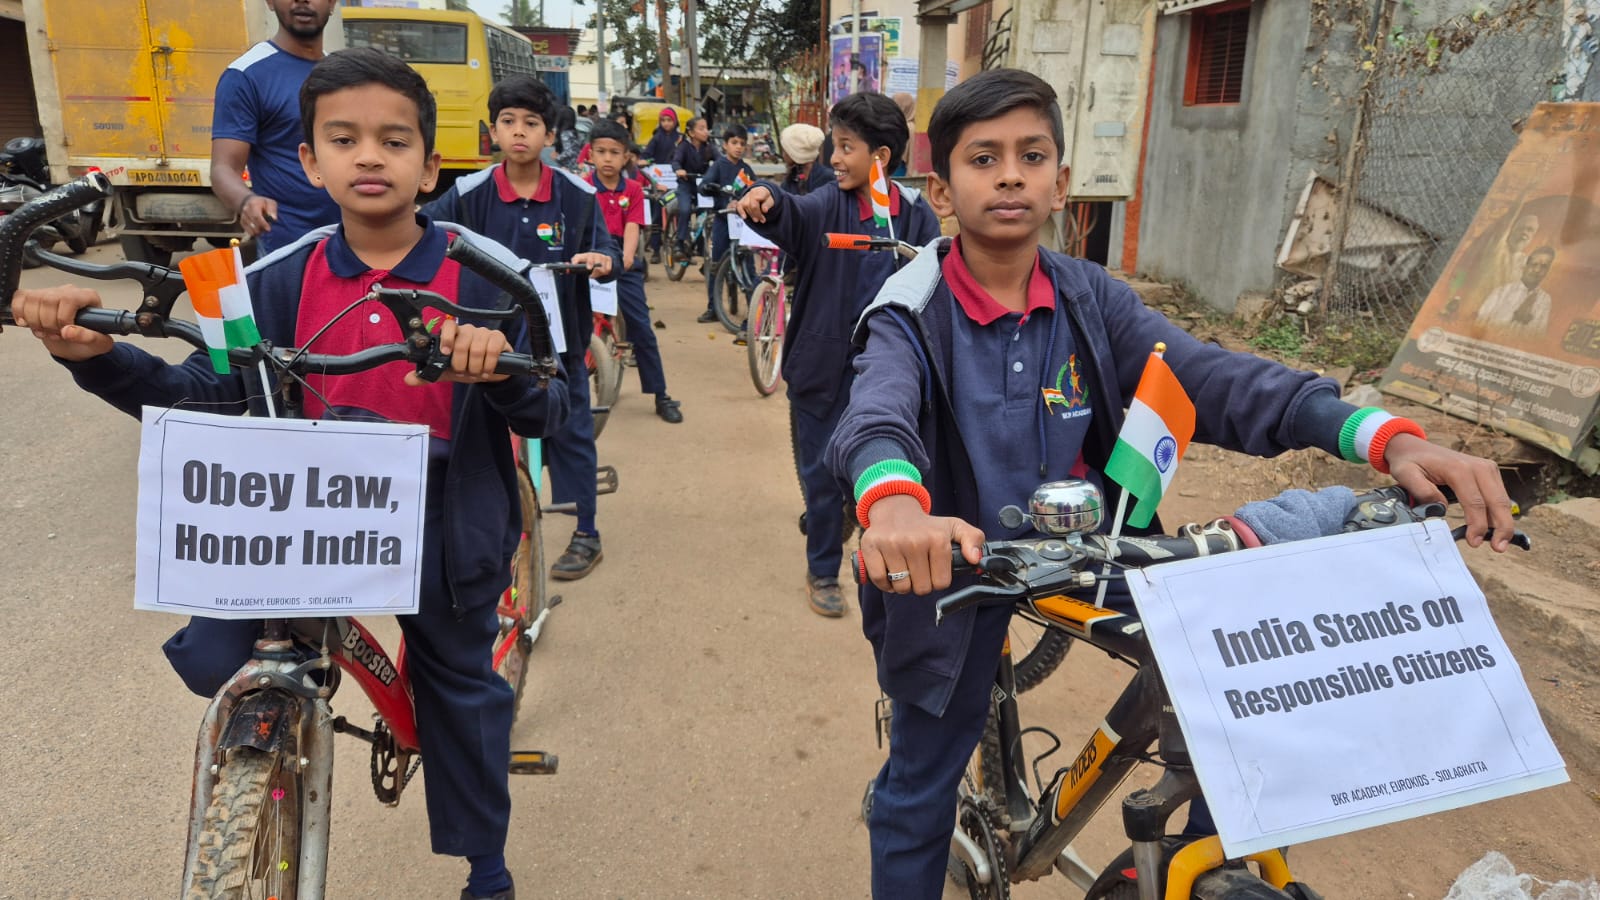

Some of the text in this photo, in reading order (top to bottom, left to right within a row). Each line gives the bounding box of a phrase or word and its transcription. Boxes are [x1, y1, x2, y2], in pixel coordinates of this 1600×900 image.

[183, 460, 399, 513] Obey Law,
[176, 523, 401, 565] Honor India
[215, 597, 229, 606] BKR
[231, 597, 265, 607] ACADEMY,
[266, 597, 300, 606] EUROKIDS
[308, 596, 353, 605] SIDLAGHATTA
[342, 625, 397, 685] Booster
[1212, 595, 1464, 668] India Stands on
[1224, 643, 1497, 719] Responsible Citizens
[1331, 793, 1350, 806] BKR
[1351, 783, 1391, 801] ACADEMY,
[1390, 774, 1430, 793] EUROKIDS
[1435, 761, 1488, 782] SIDLAGHATTA
